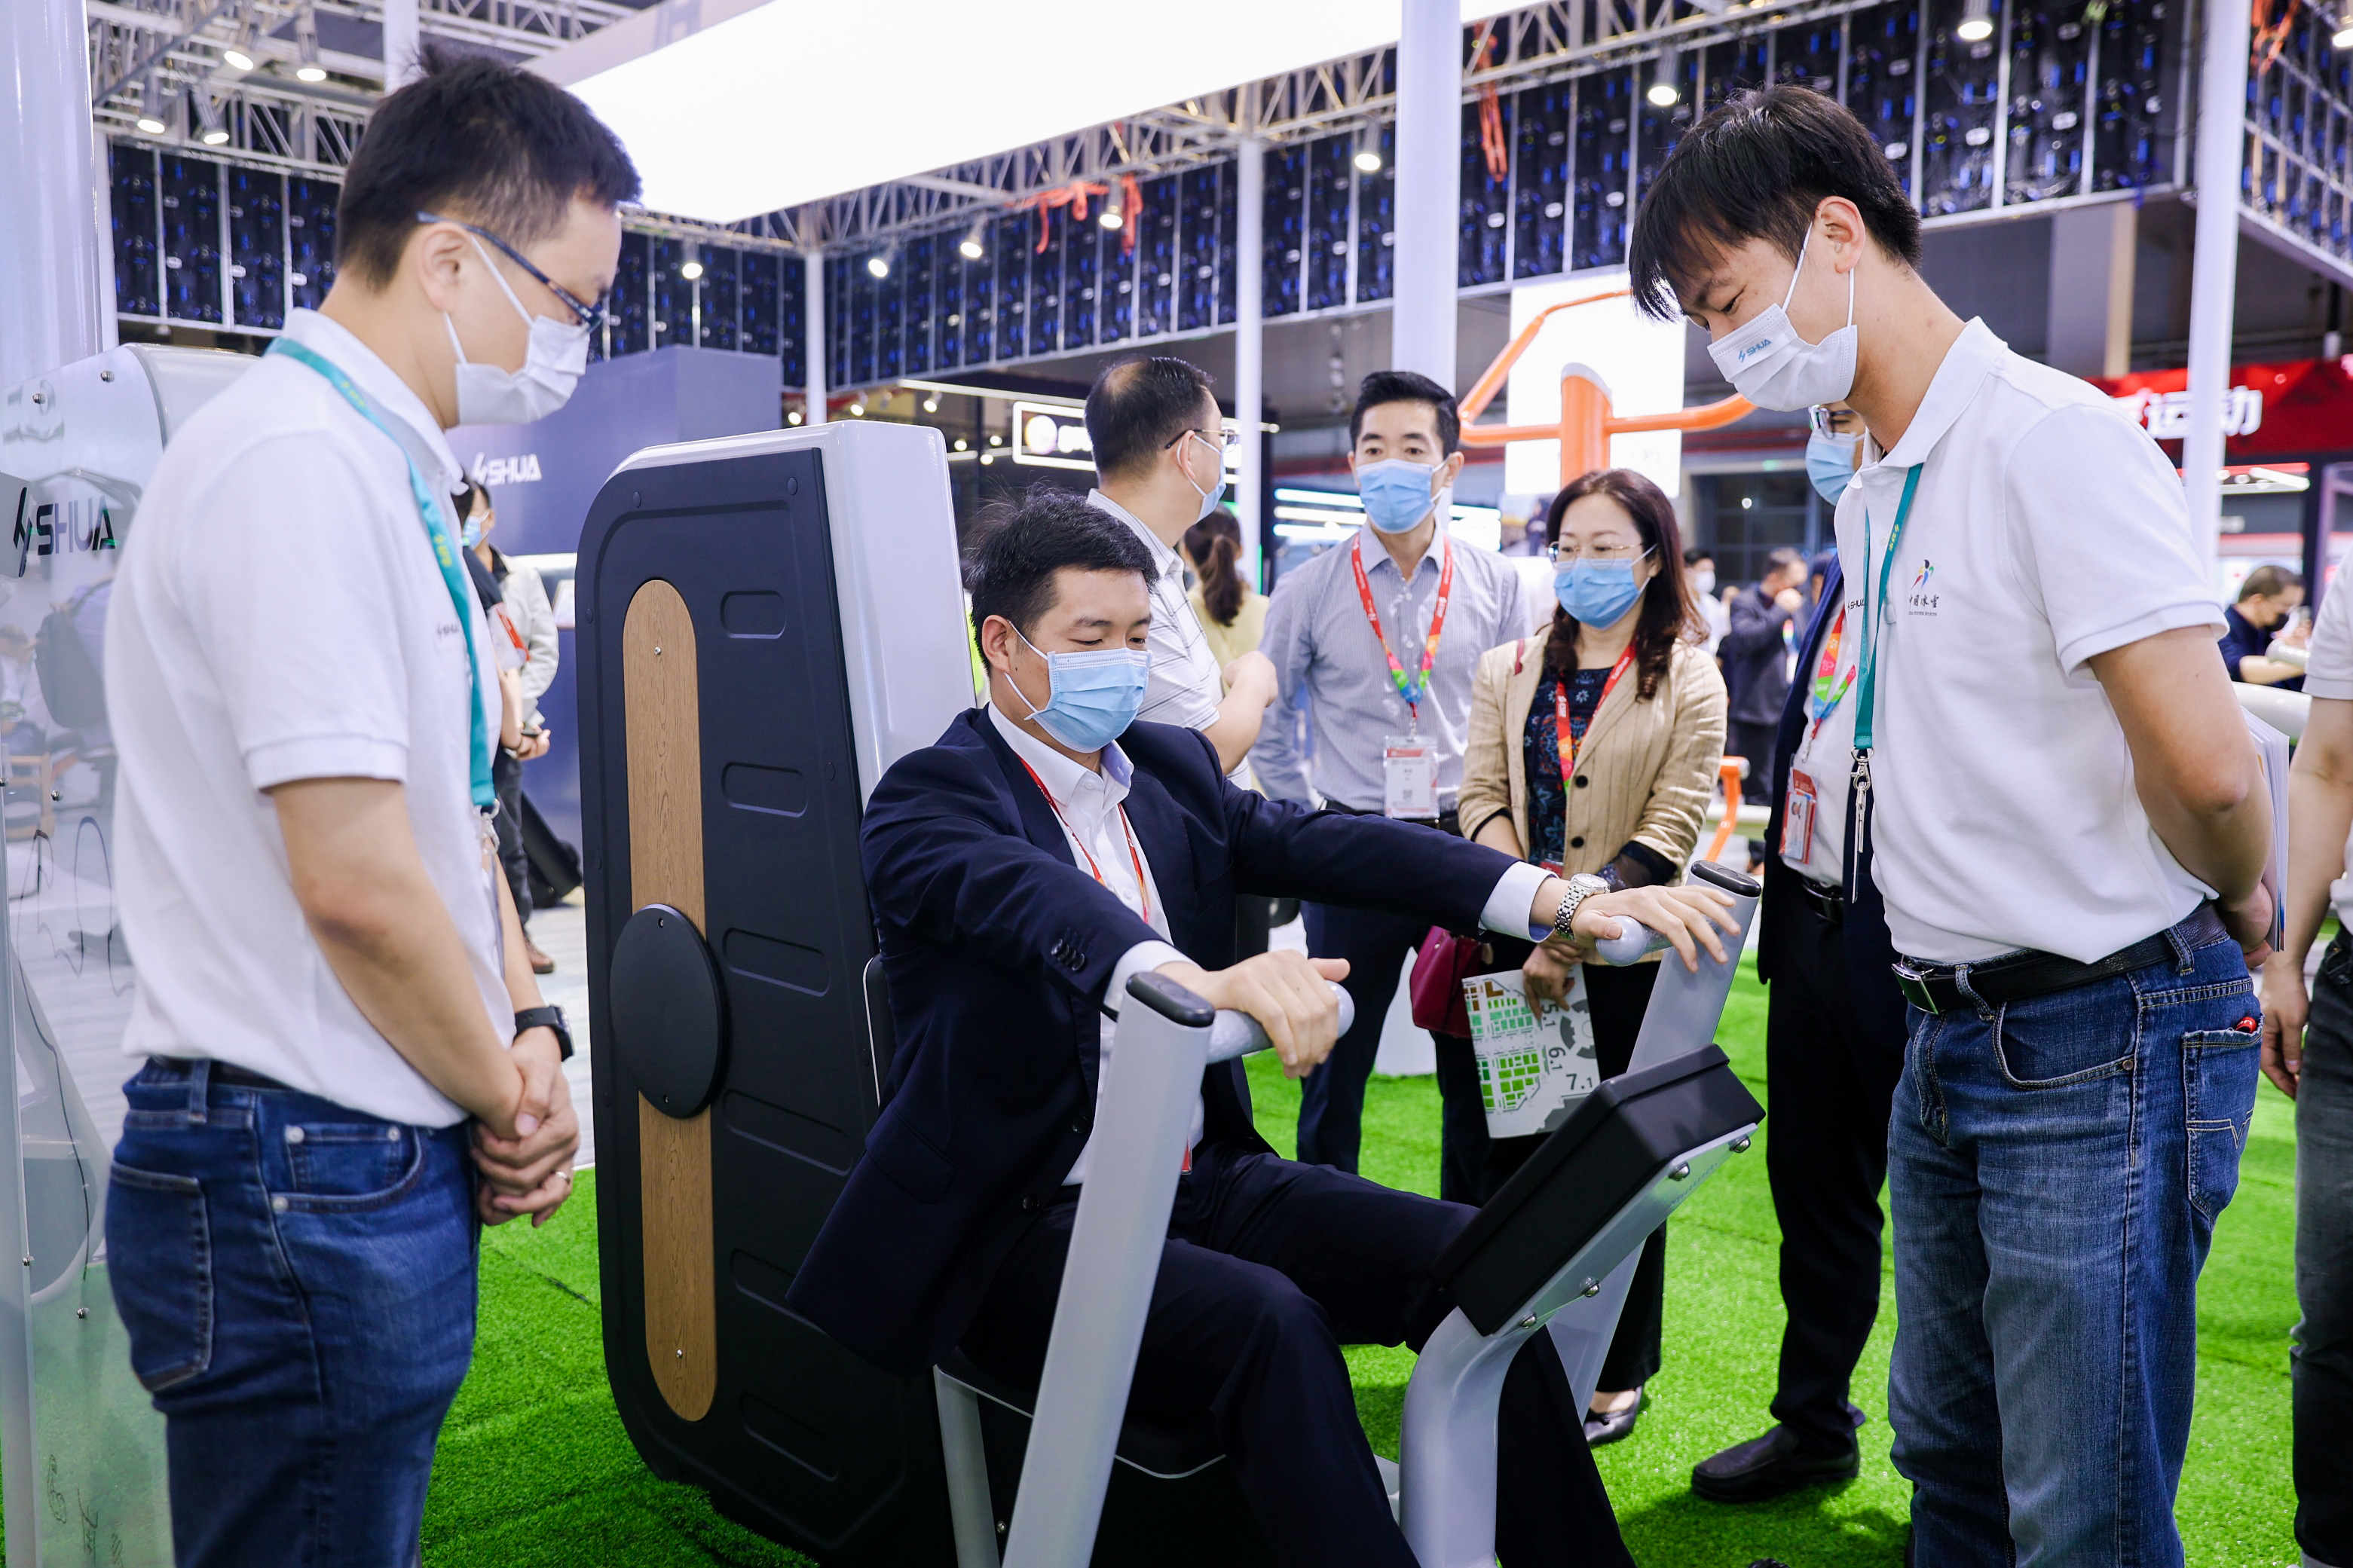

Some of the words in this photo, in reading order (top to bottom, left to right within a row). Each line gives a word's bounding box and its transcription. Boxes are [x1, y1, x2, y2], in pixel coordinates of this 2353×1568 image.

[1746, 339, 1772, 356] SHUA
[2113, 386, 2263, 439] 运动
[485, 454, 542, 487] SHUA
[36, 495, 116, 556] SHUA
[1541, 1004, 1559, 1027] 5.1
[1548, 1047, 1566, 1070] 6.1
[1566, 1073, 1593, 1090] 7.1
